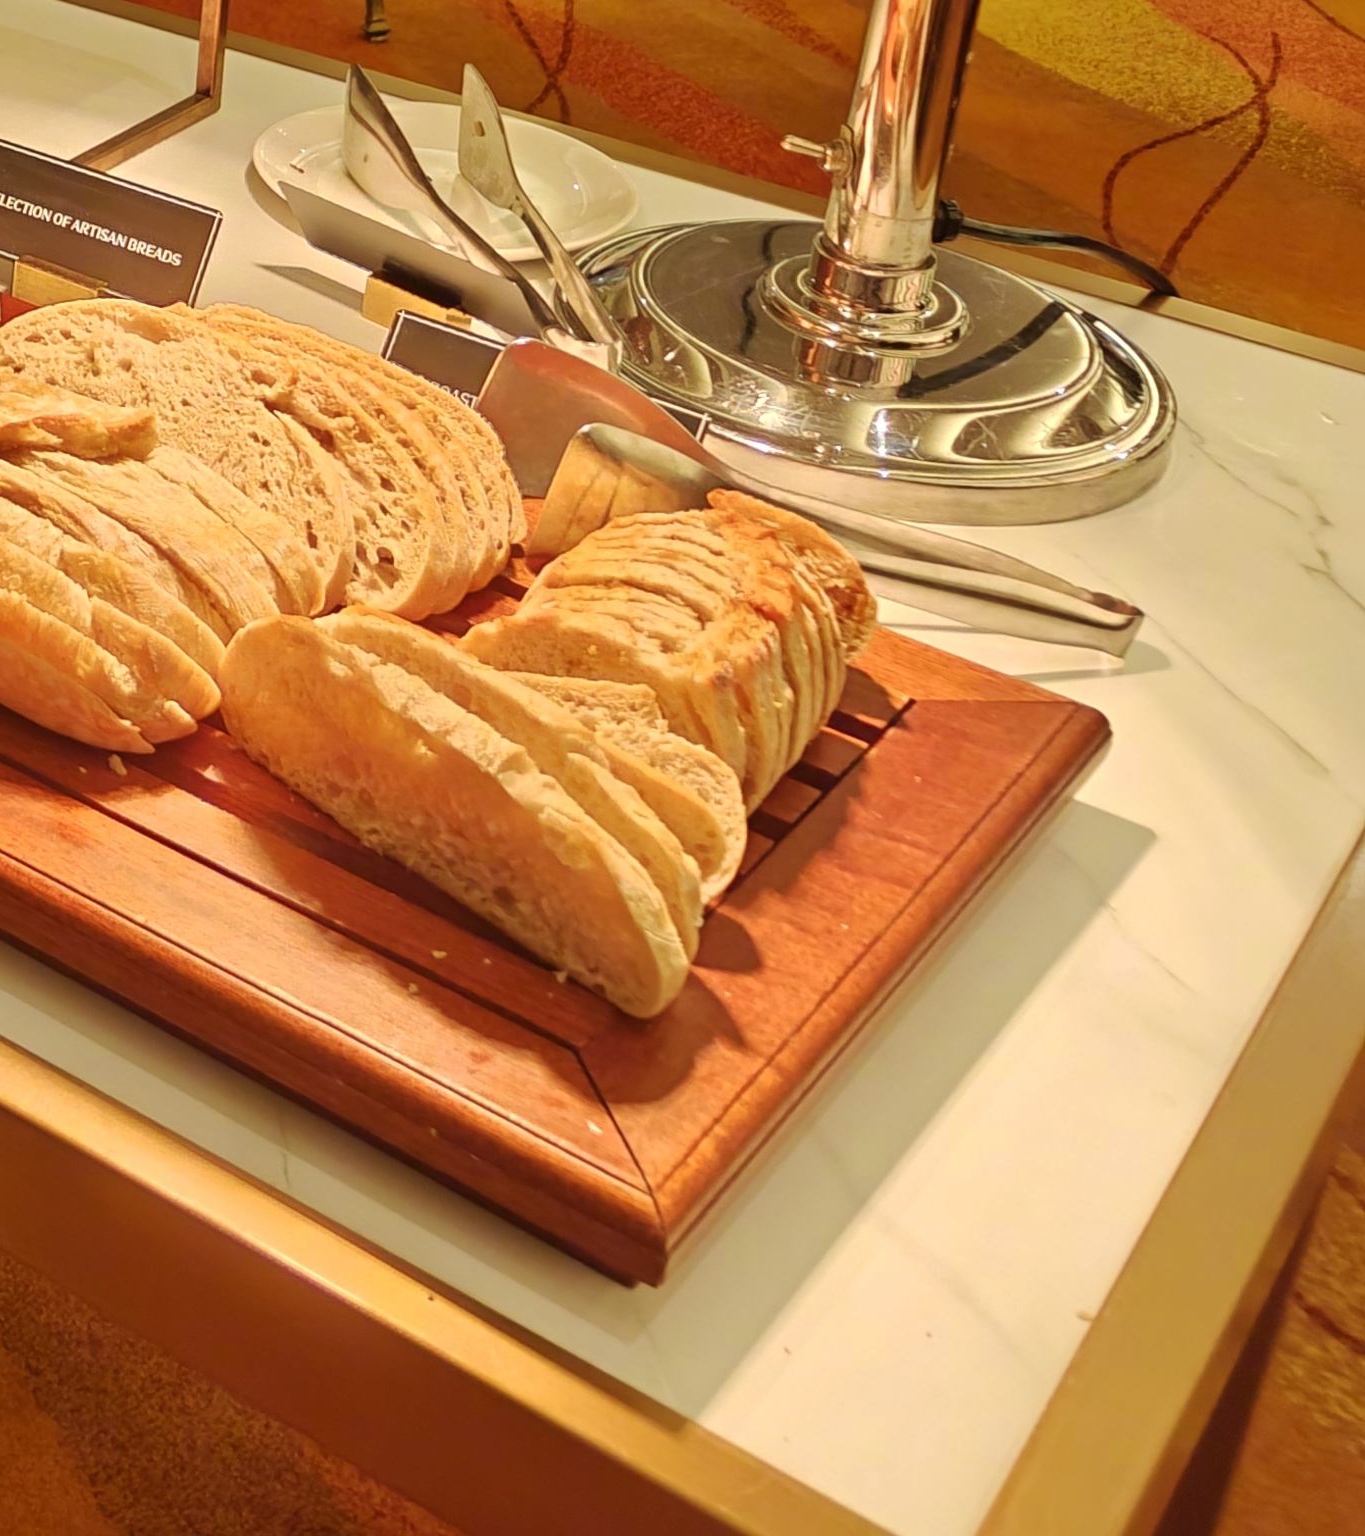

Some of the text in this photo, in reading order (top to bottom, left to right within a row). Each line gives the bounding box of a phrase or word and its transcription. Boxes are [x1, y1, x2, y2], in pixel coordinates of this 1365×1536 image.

[52, 212, 72, 228] OF
[70, 219, 128, 248] ARTISAN
[127, 238, 182, 266] BREADS
